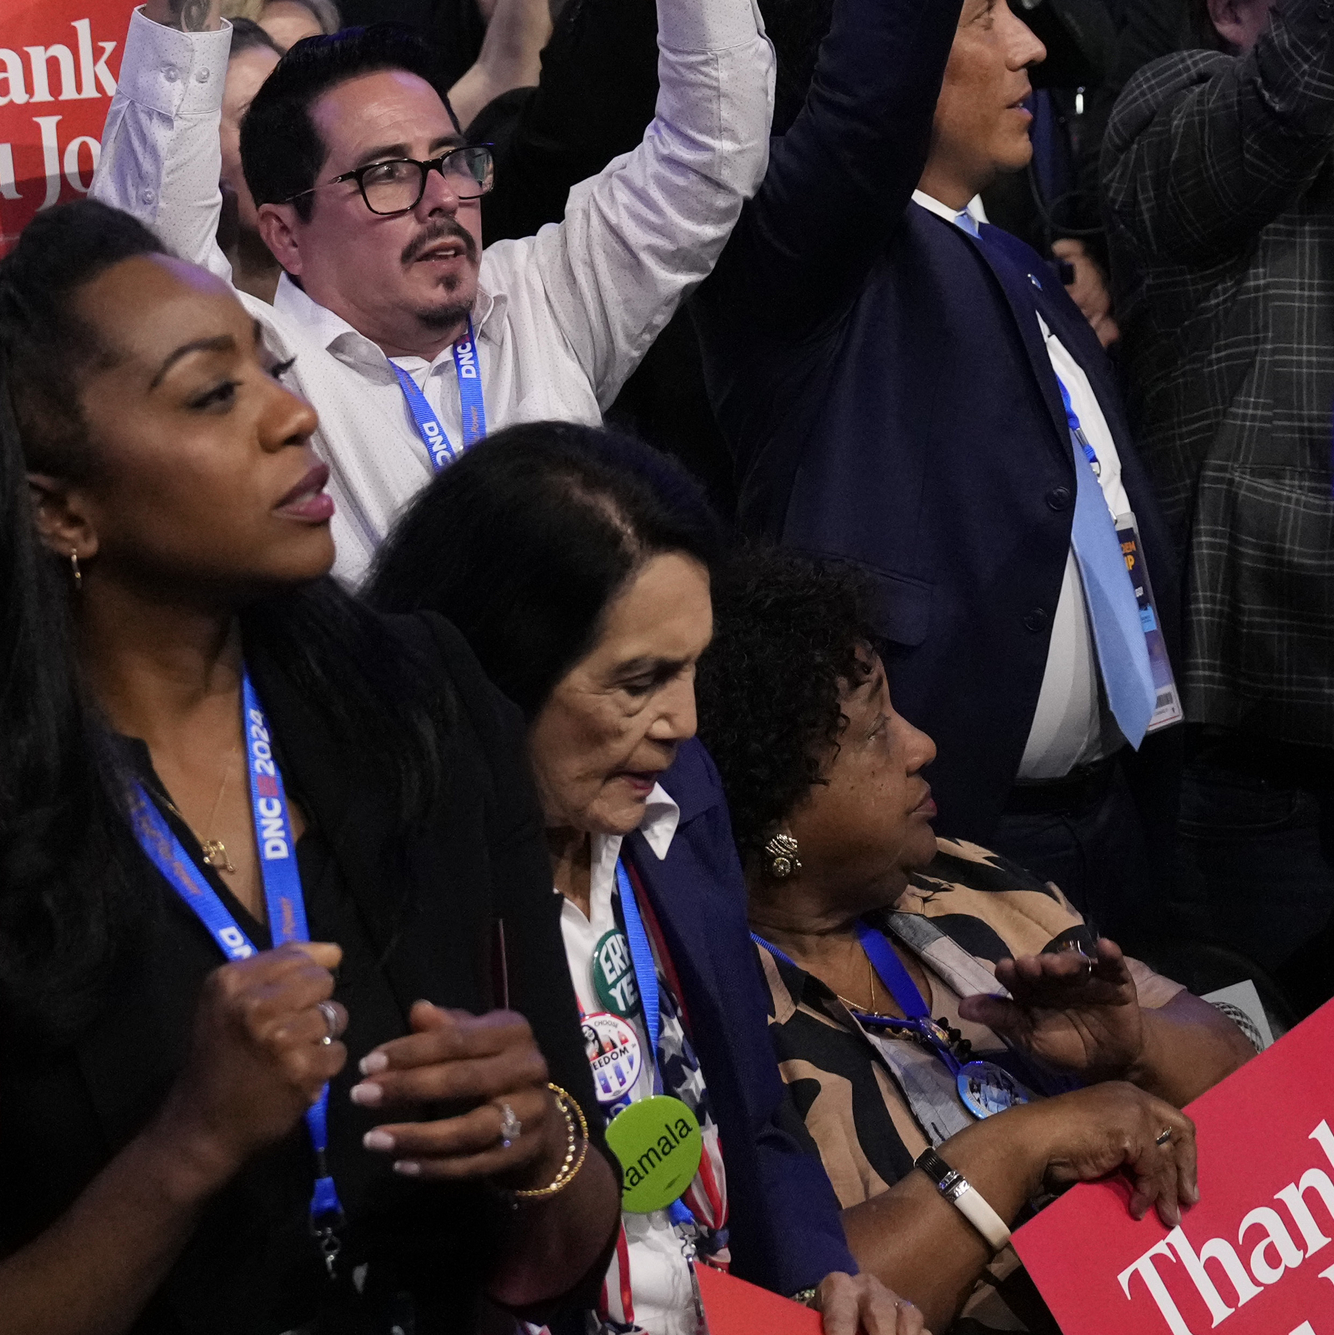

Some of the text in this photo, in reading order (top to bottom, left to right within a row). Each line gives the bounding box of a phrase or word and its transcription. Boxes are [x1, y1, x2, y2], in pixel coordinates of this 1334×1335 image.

[31, 115, 101, 212] Jo
[457, 342, 477, 379] DNC
[422, 421, 453, 467] DNC
[248, 709, 290, 860] 2024 DNC
[599, 933, 634, 985] ER
[609, 974, 640, 1011] YE
[591, 1046, 630, 1071] EEDOM
[622, 1117, 694, 1193] amala
